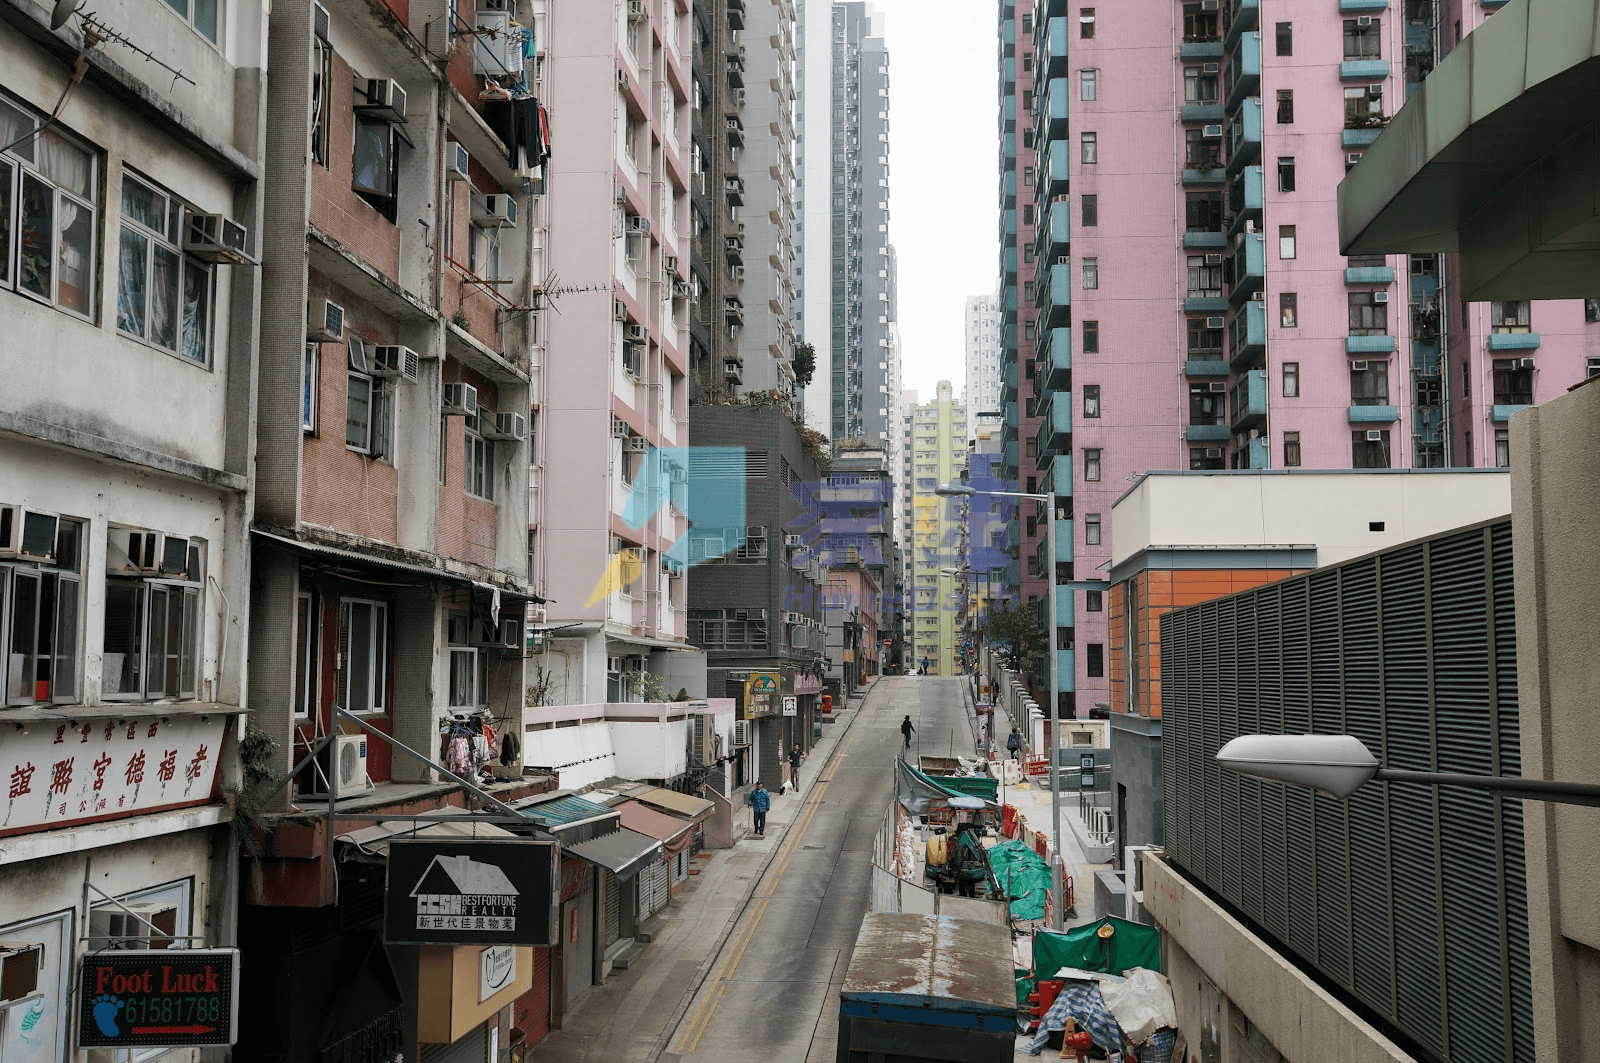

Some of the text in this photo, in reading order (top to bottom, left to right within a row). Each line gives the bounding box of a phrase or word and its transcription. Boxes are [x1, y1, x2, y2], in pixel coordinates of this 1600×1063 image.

[461, 895, 517, 906] BEST FORTUNE
[461, 905, 516, 916] REALTY
[419, 916, 513, 930] 新世代佳景物業
[95, 965, 219, 994] Foot Luck
[125, 997, 219, 1023] 61581788
